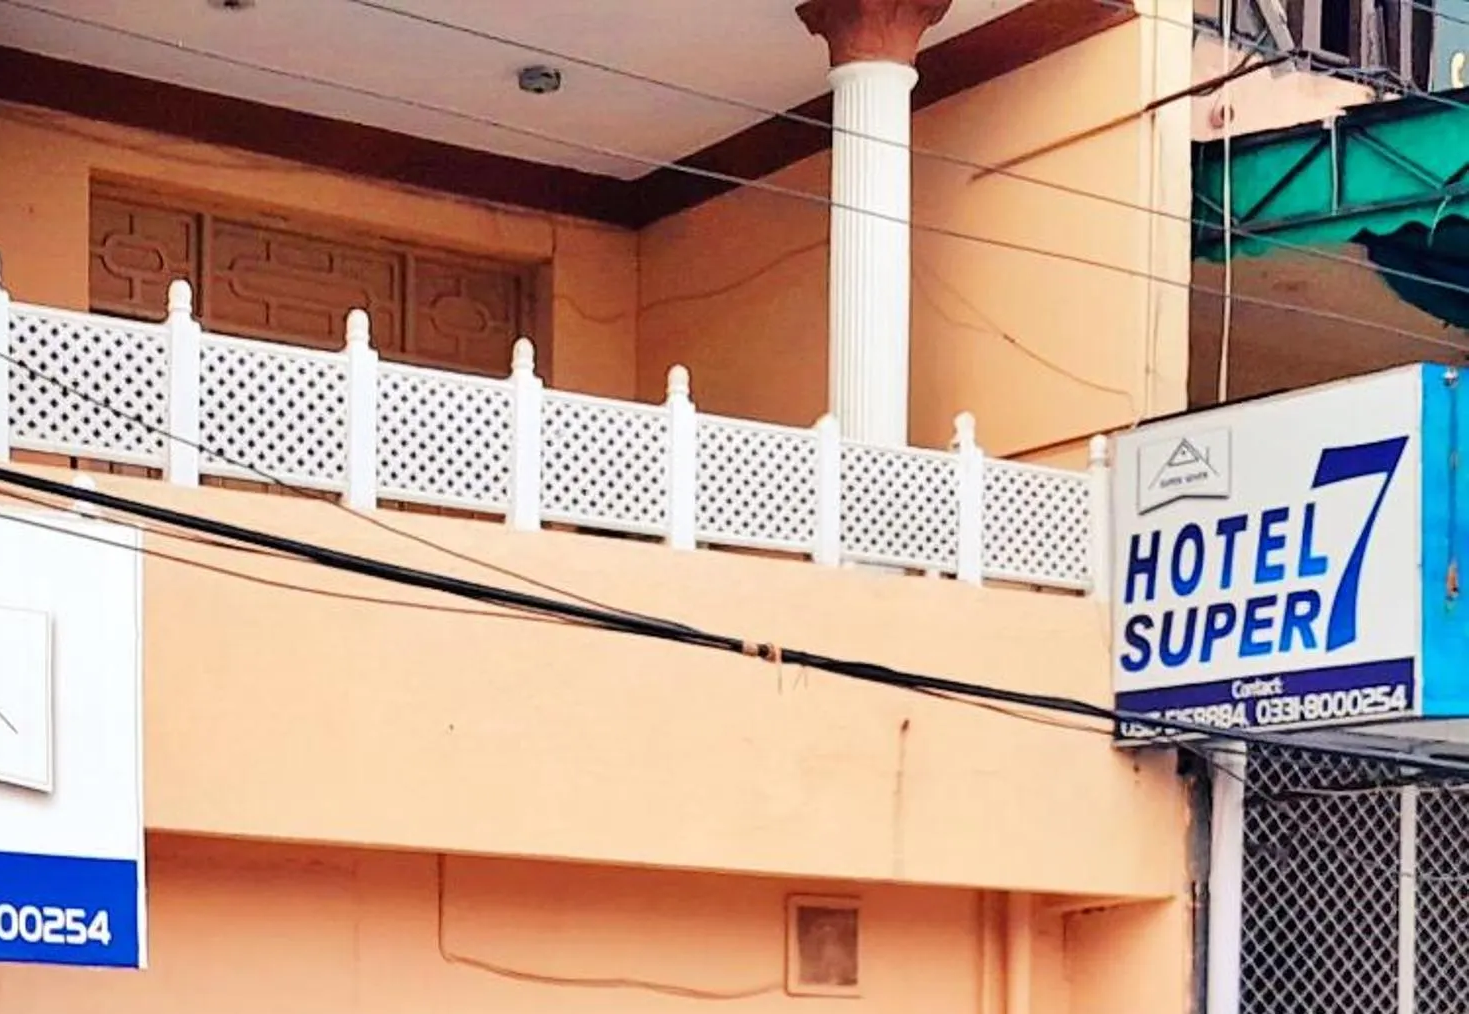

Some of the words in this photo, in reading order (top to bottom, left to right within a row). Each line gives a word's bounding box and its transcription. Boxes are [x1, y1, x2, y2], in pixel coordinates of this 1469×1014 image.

[1124, 502, 1328, 605] HOTEL
[1312, 436, 1409, 652] 7
[1120, 589, 1321, 673] SUPER
[1256, 684, 1408, 725] 0331-8000254
